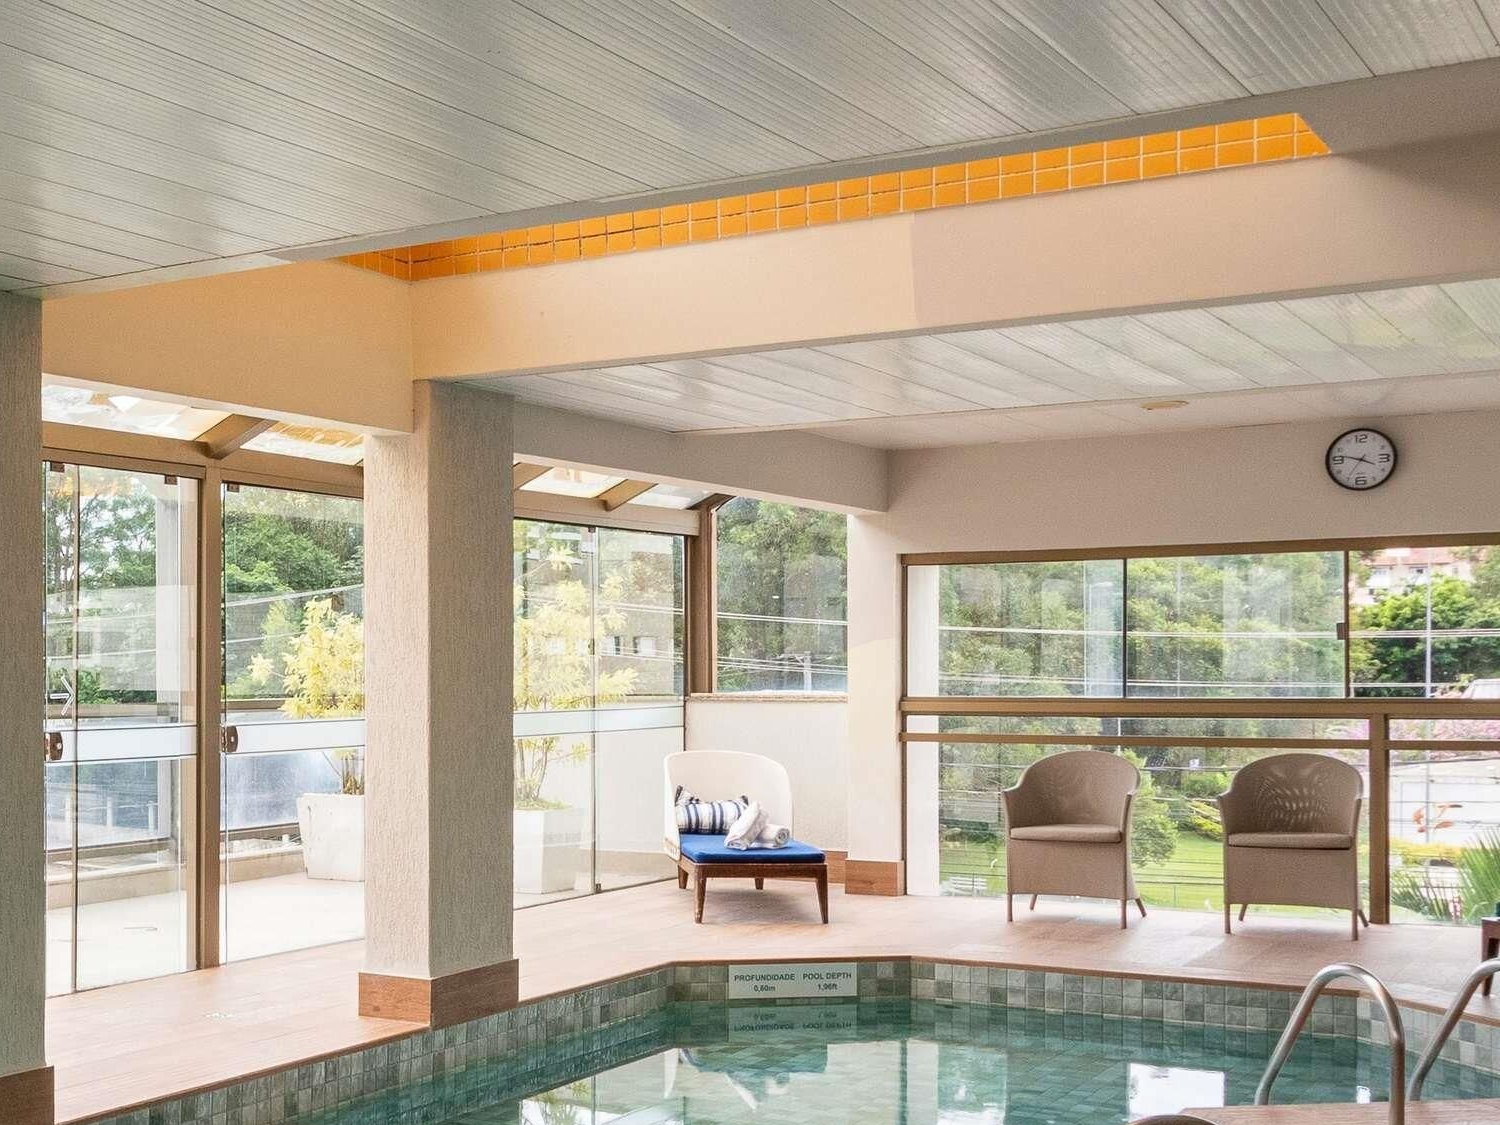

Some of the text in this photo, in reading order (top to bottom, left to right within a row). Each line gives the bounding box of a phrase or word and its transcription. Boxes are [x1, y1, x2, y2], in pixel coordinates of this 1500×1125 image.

[1355, 434, 1368, 443] 12
[1332, 455, 1345, 465] 9
[1378, 453, 1390, 463] 3
[1355, 476, 1367, 485] 6
[734, 973, 795, 982] PROFUNDIDADE
[826, 972, 852, 980] DEPTH
